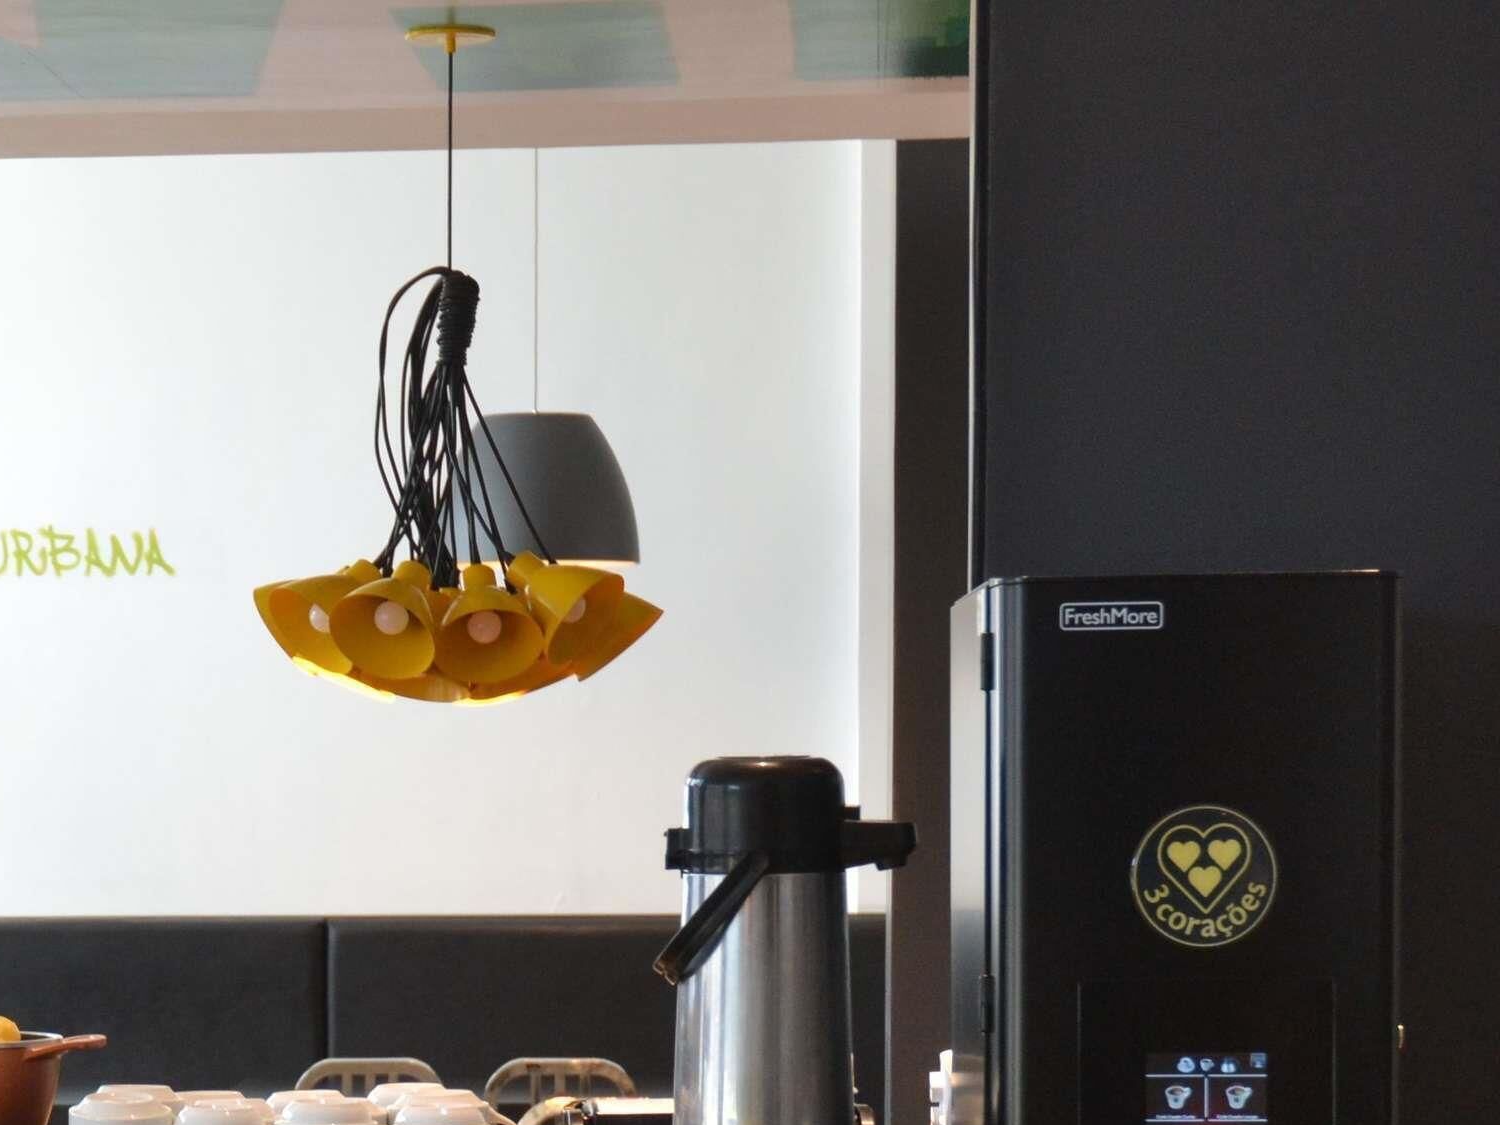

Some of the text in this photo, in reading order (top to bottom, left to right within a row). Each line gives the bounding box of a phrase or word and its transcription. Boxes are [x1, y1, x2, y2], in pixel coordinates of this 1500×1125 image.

[1064, 607, 1158, 625] FreshMore
[1143, 882, 1268, 937] 3 corações
